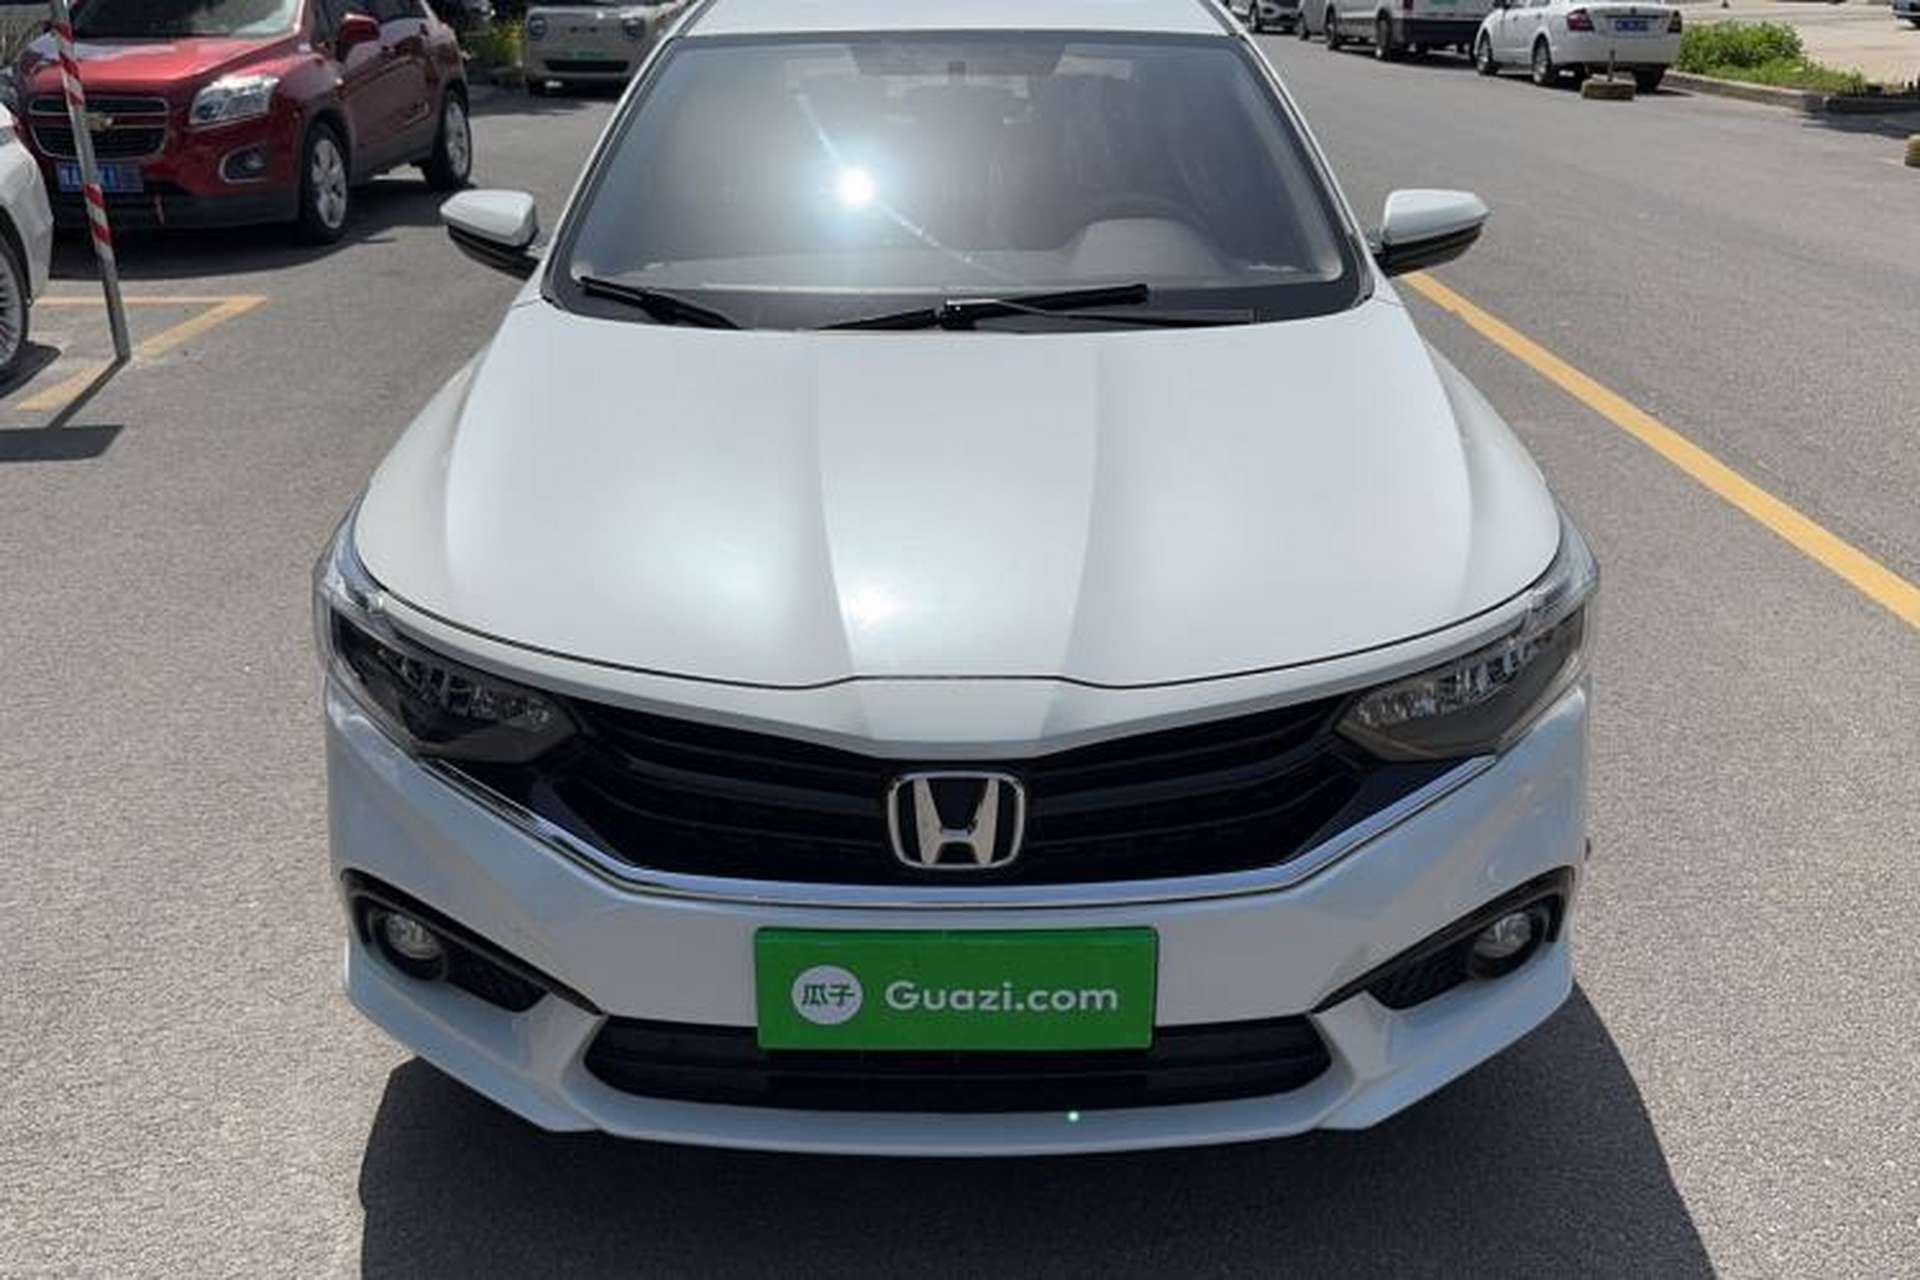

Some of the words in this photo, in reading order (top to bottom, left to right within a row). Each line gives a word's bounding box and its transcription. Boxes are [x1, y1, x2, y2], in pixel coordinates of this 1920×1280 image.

[912, 774, 1000, 866] H
[802, 983, 856, 1007] 瓜子
[885, 980, 1119, 1012] Guazi.com
